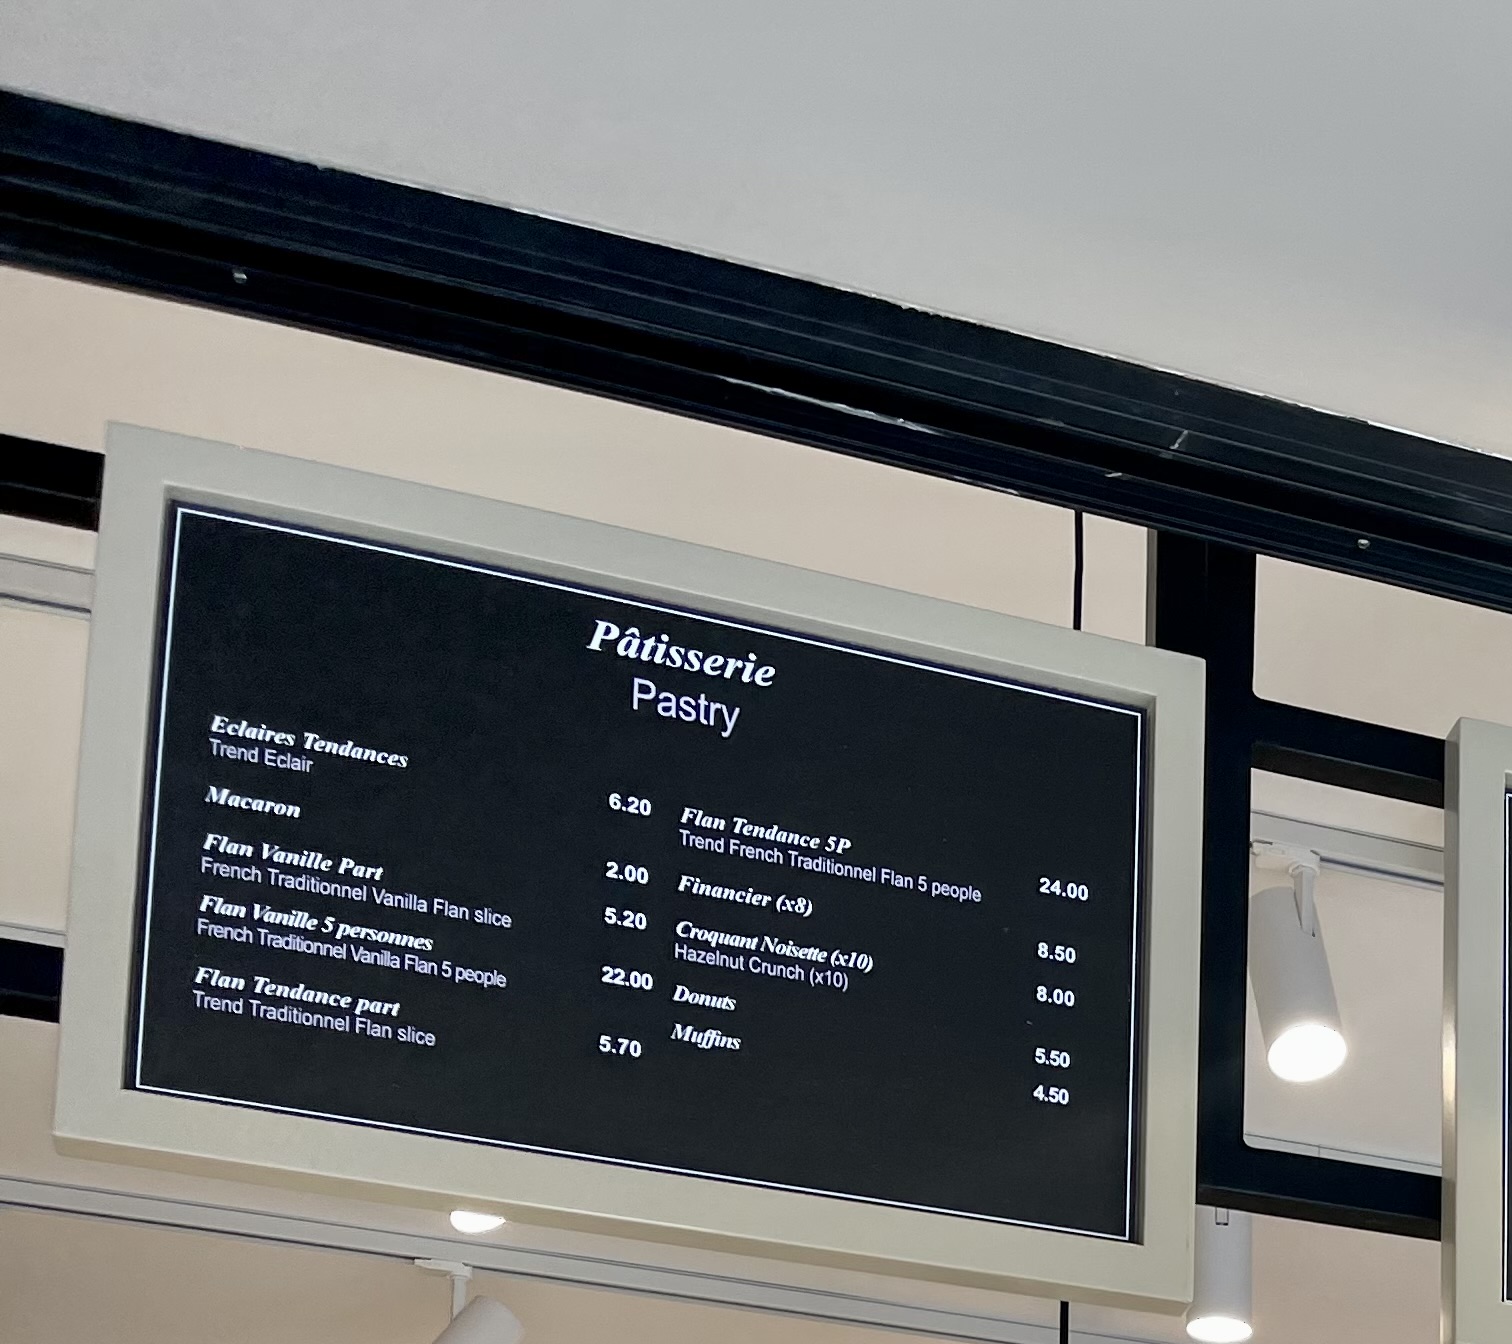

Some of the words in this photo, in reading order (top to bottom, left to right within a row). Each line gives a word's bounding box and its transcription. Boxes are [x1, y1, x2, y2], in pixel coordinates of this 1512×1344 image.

[585, 619, 775, 686] Pâtisserie
[632, 676, 740, 737] Pastry
[208, 737, 259, 763] Trend
[263, 747, 314, 772] Eclair
[210, 714, 296, 746] Eclaires
[303, 731, 408, 768] Tendances
[204, 785, 301, 818] Macaron
[608, 792, 651, 816] 6.20
[679, 806, 726, 831] Flan
[732, 816, 820, 849] Tendance
[824, 835, 851, 854] 5P
[202, 832, 253, 857] Flan
[261, 841, 333, 871] Vanille
[337, 856, 383, 880] Part
[605, 860, 649, 884] 2.00
[678, 828, 724, 853] Trend
[729, 838, 783, 864] French
[787, 849, 876, 882] Traditionnel
[880, 867, 913, 889] Flan
[917, 875, 927, 892] 5
[931, 881, 982, 902] people
[200, 855, 262, 883] French
[266, 867, 367, 901] Traditionnel
[371, 886, 427, 912] Vanilla
[432, 897, 469, 920] Flan
[473, 907, 512, 927] slice
[677, 874, 772, 907] Financier
[775, 894, 813, 917] (x8)
[1038, 876, 1088, 901] 24.00
[198, 894, 246, 918] Flan
[252, 902, 318, 930] Vanille
[320, 915, 336, 933] 5
[334, 922, 433, 951] personnes
[603, 906, 647, 930] 5.20
[196, 917, 253, 943] French
[256, 927, 347, 960] Traditionnel
[349, 943, 400, 969] Vanilla
[403, 953, 438, 975] Flan
[440, 960, 452, 978] 5
[454, 966, 506, 988] people
[675, 920, 759, 950] Croquant
[759, 935, 827, 962] Noisette
[829, 948, 873, 973] (x10)
[1036, 941, 1076, 963] 8.50
[600, 965, 653, 990] 22.00
[674, 942, 744, 971] Hazelnut
[748, 955, 804, 981] Crunch
[809, 966, 848, 992] (x10)
[193, 965, 245, 990] Flan
[253, 975, 352, 1008] Tendance
[353, 998, 400, 1016] part
[672, 984, 736, 1010] Donuts
[1036, 985, 1075, 1007] 8.00
[192, 989, 243, 1014] Trend
[248, 998, 350, 1032] Traditionnel
[354, 1016, 392, 1038] Flan
[396, 1025, 436, 1046] slice
[669, 1023, 741, 1050] Muffins
[598, 1034, 642, 1058] 5.70
[1034, 1046, 1070, 1068] 5.50
[1032, 1084, 1069, 1105] 4.50
